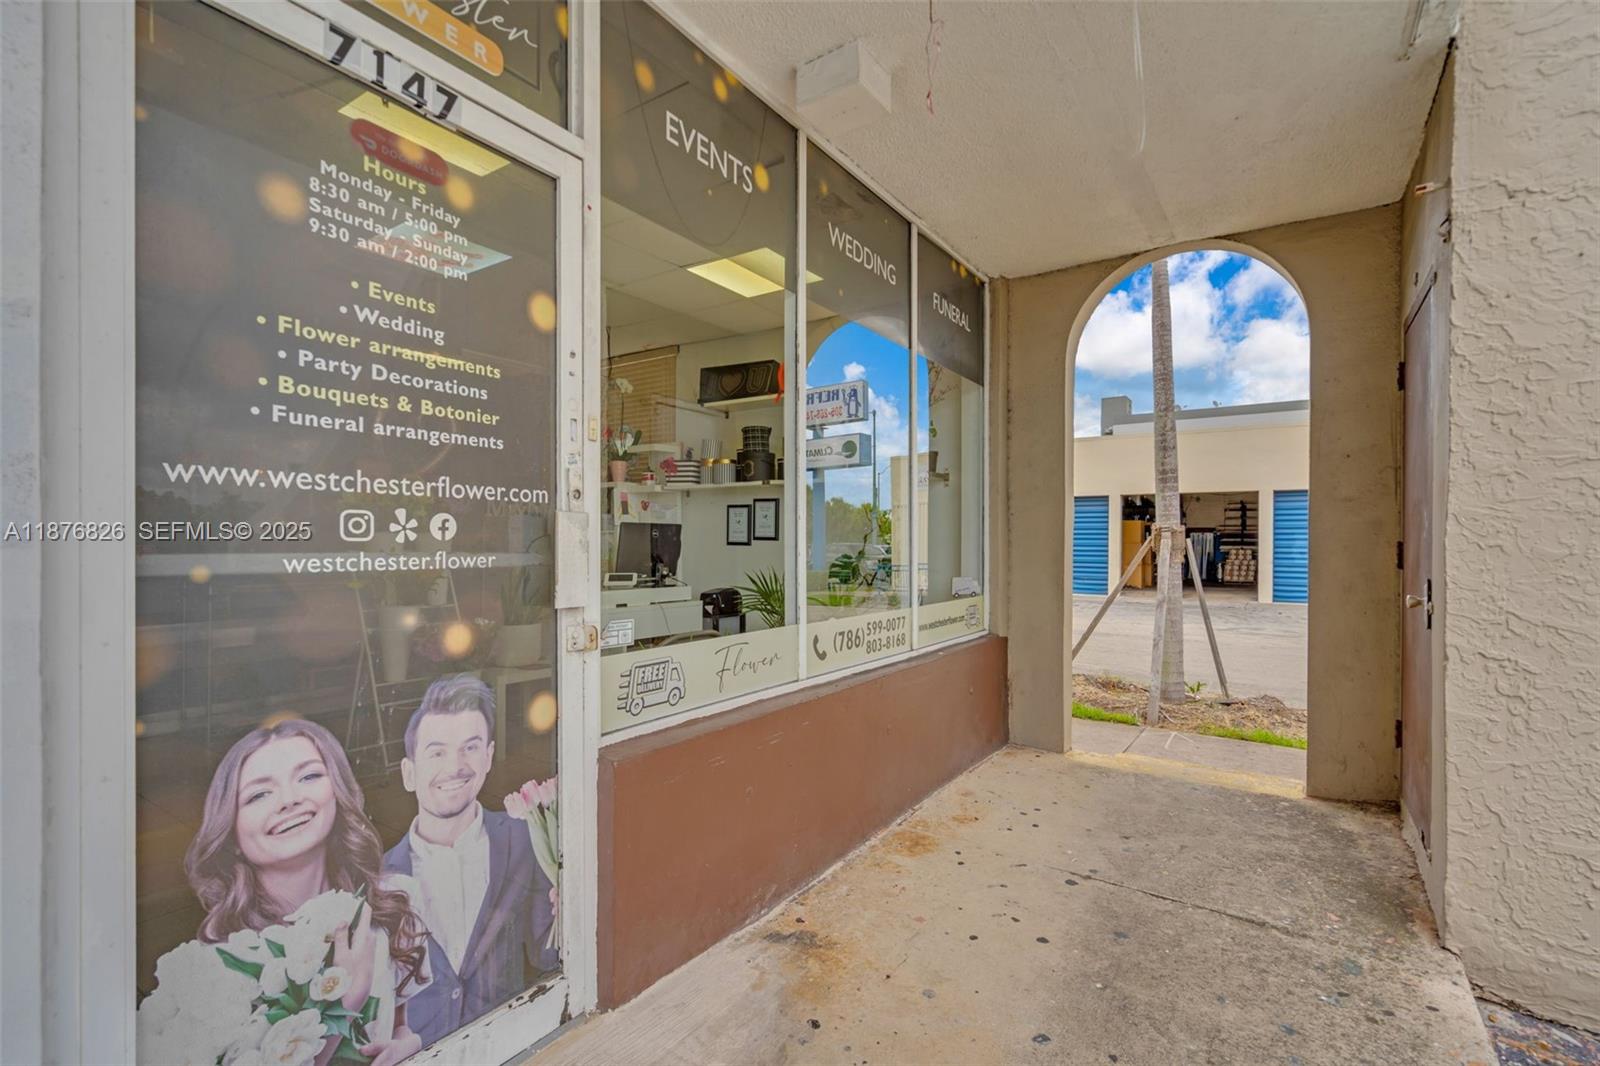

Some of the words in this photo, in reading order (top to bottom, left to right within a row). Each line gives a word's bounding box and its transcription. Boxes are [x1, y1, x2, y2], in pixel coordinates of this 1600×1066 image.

[328, 25, 459, 120] 7147
[363, 155, 428, 195] Hours
[665, 110, 754, 194] EVENTS
[309, 177, 350, 203] 8:30
[357, 200, 386, 217] am
[405, 212, 438, 235] 5:00
[444, 230, 469, 247] pm
[320, 159, 392, 203] Monday
[412, 196, 461, 229] Friday
[309, 197, 394, 238] Saturday
[413, 234, 469, 266] Sunday
[309, 218, 350, 243] 9:30
[357, 238, 386, 256] am
[405, 249, 438, 271] 2:00
[444, 266, 469, 281] pm
[828, 221, 897, 286] WEDDING
[368, 281, 437, 315] Events
[932, 291, 972, 333] FUNERAL
[278, 315, 361, 349] Flower
[368, 339, 502, 379] arrangements
[353, 304, 446, 346] Wedding
[298, 349, 363, 380] Party
[371, 363, 489, 400] Decorations
[278, 375, 390, 410] Bouquets
[397, 395, 413, 413] &
[421, 400, 501, 426] Botonier
[272, 405, 364, 433] Funeral
[373, 421, 505, 450] arrangements
[162, 462, 549, 504] www.westchesterflower.com
[283, 551, 497, 573] westchester.flower
[833, 626, 866, 654] (786)
[866, 616, 906, 637] 599-0077
[866, 632, 906, 655] 803-8168
[639, 663, 667, 683] FREE
[714, 641, 782, 693] Flower
